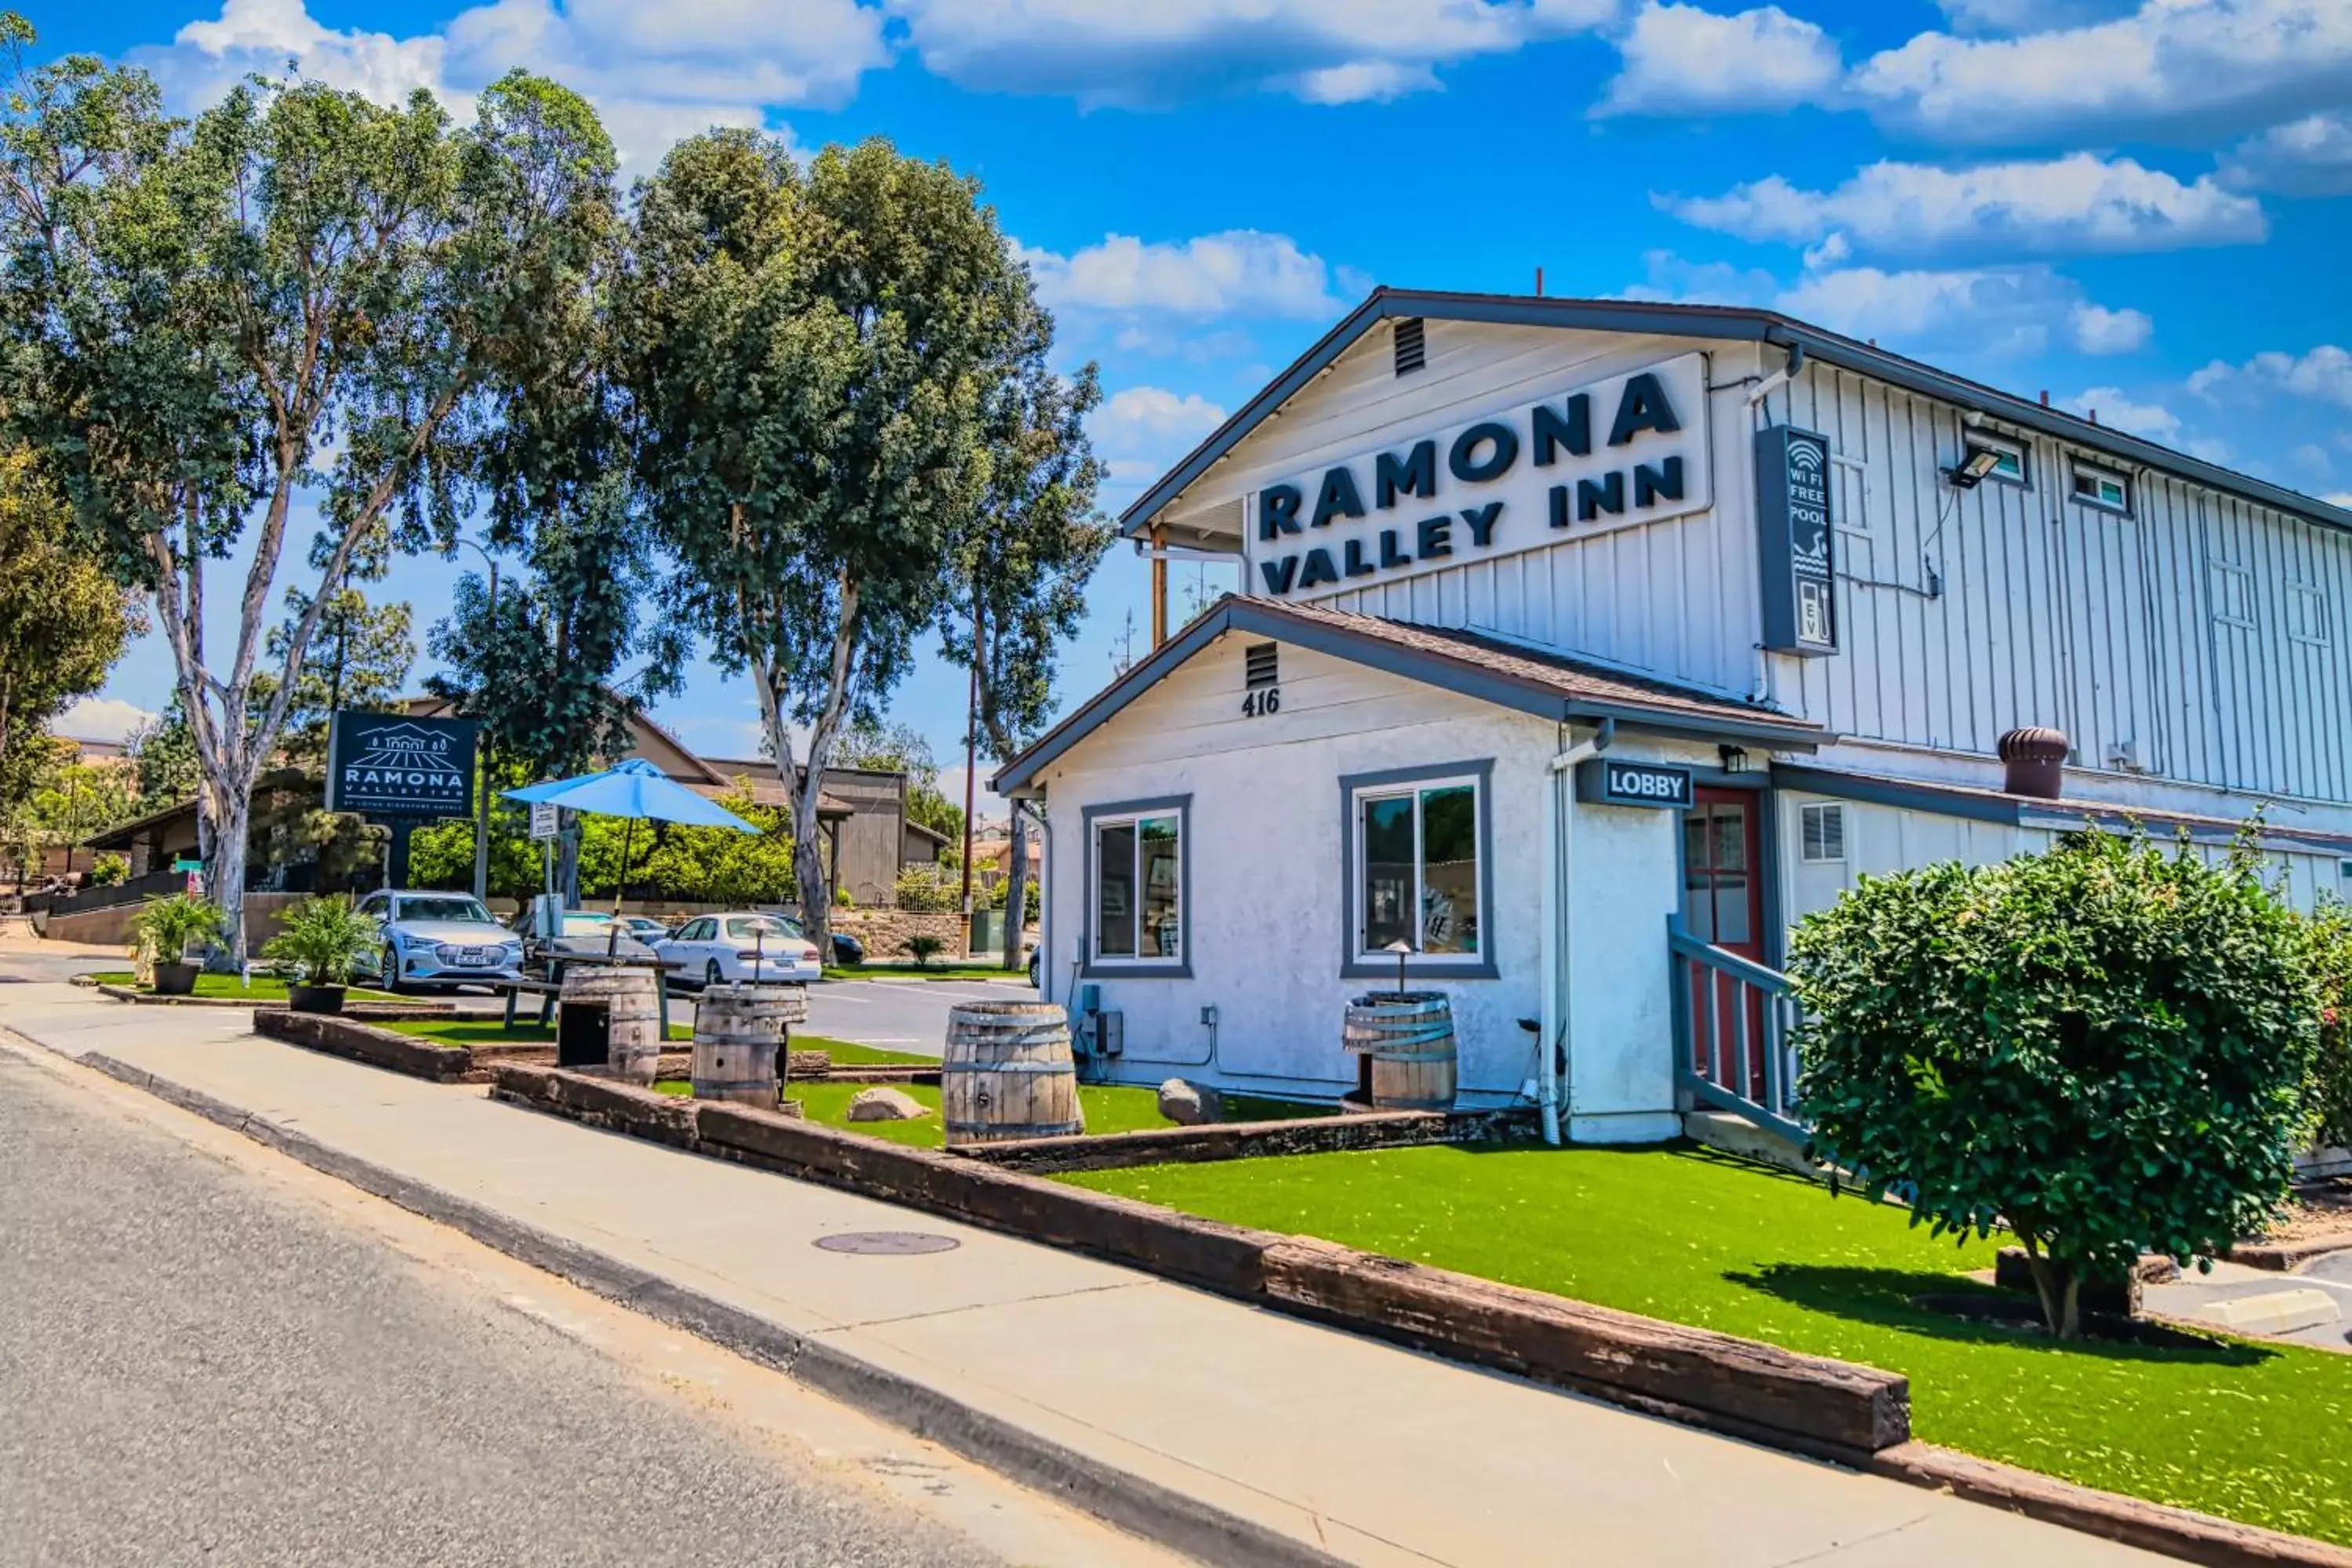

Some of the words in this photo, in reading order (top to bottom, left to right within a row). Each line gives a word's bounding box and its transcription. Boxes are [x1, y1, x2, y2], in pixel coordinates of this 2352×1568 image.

[1259, 372, 1681, 543] RAMONA
[1791, 484, 1826, 503] FREE
[1260, 502, 1504, 595] VALLEY
[1549, 456, 1684, 528] INN
[1791, 506, 1828, 527] POOL
[1806, 603, 1816, 634] EV
[1241, 688, 1280, 718] 416
[345, 769, 463, 788] RAMONA
[345, 784, 422, 795] VALLEY
[1611, 770, 1684, 798] LOBBY
